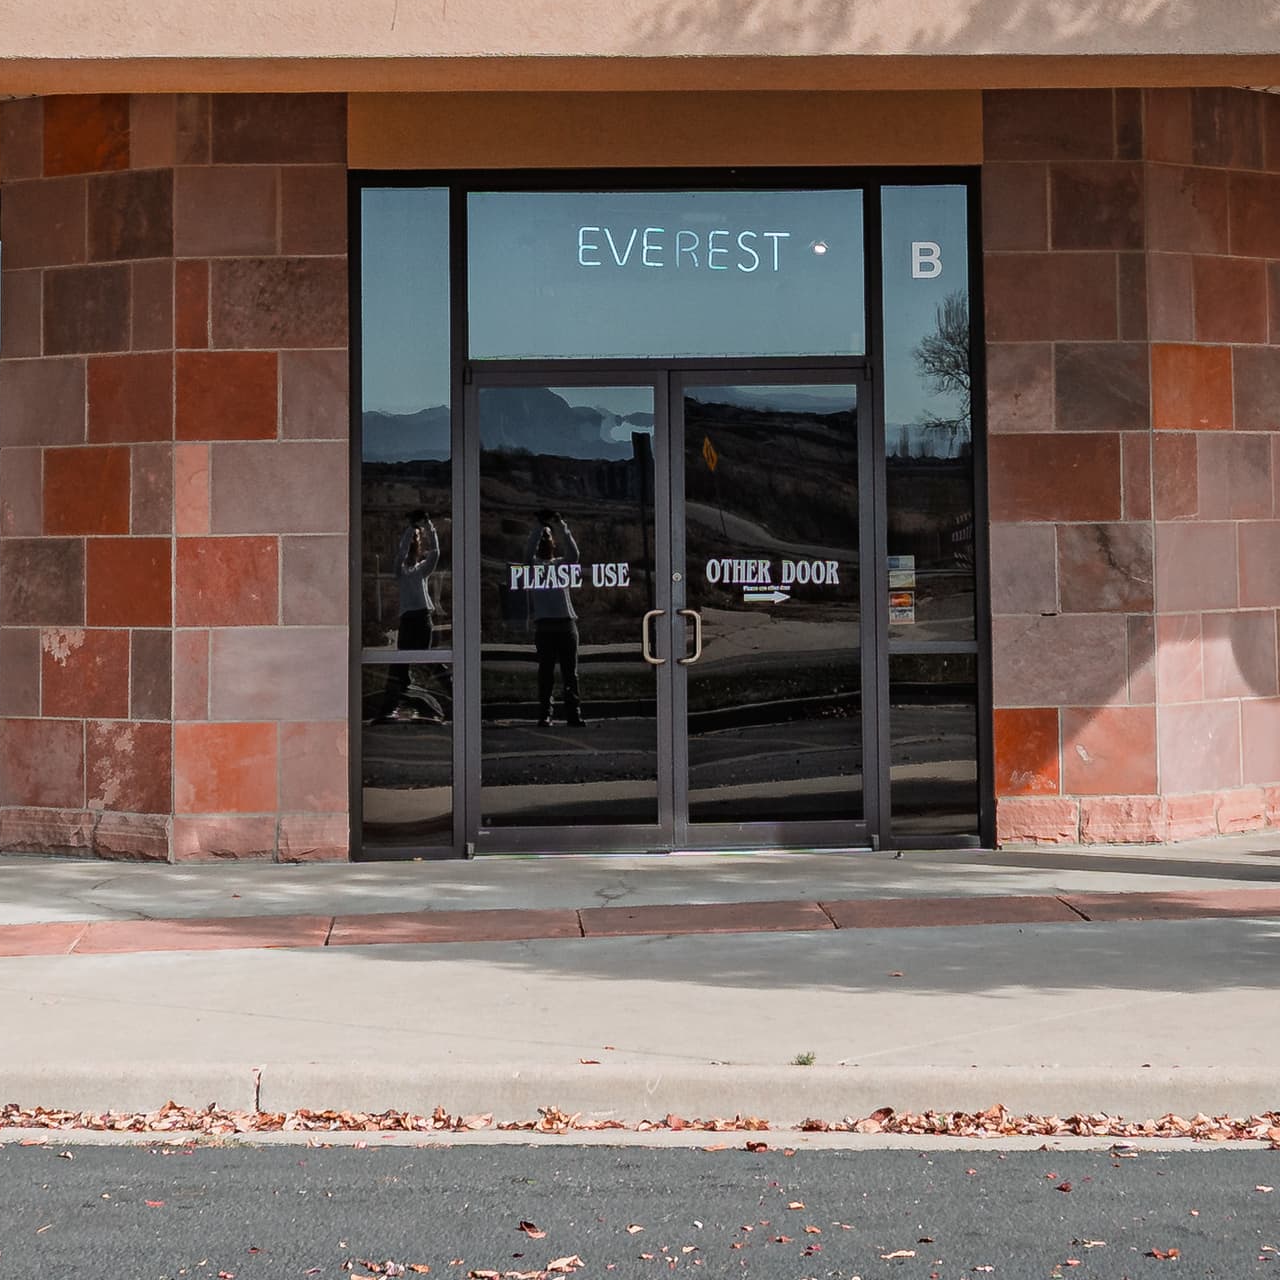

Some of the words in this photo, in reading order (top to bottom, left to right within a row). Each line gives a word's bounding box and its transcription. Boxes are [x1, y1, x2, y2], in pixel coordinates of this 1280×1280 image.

[578, 226, 791, 272] EVEREST
[910, 241, 943, 279] B
[509, 562, 583, 590] PLEASE
[591, 563, 631, 588] USE
[705, 558, 772, 584] OTHER
[781, 559, 840, 585] DOOR
